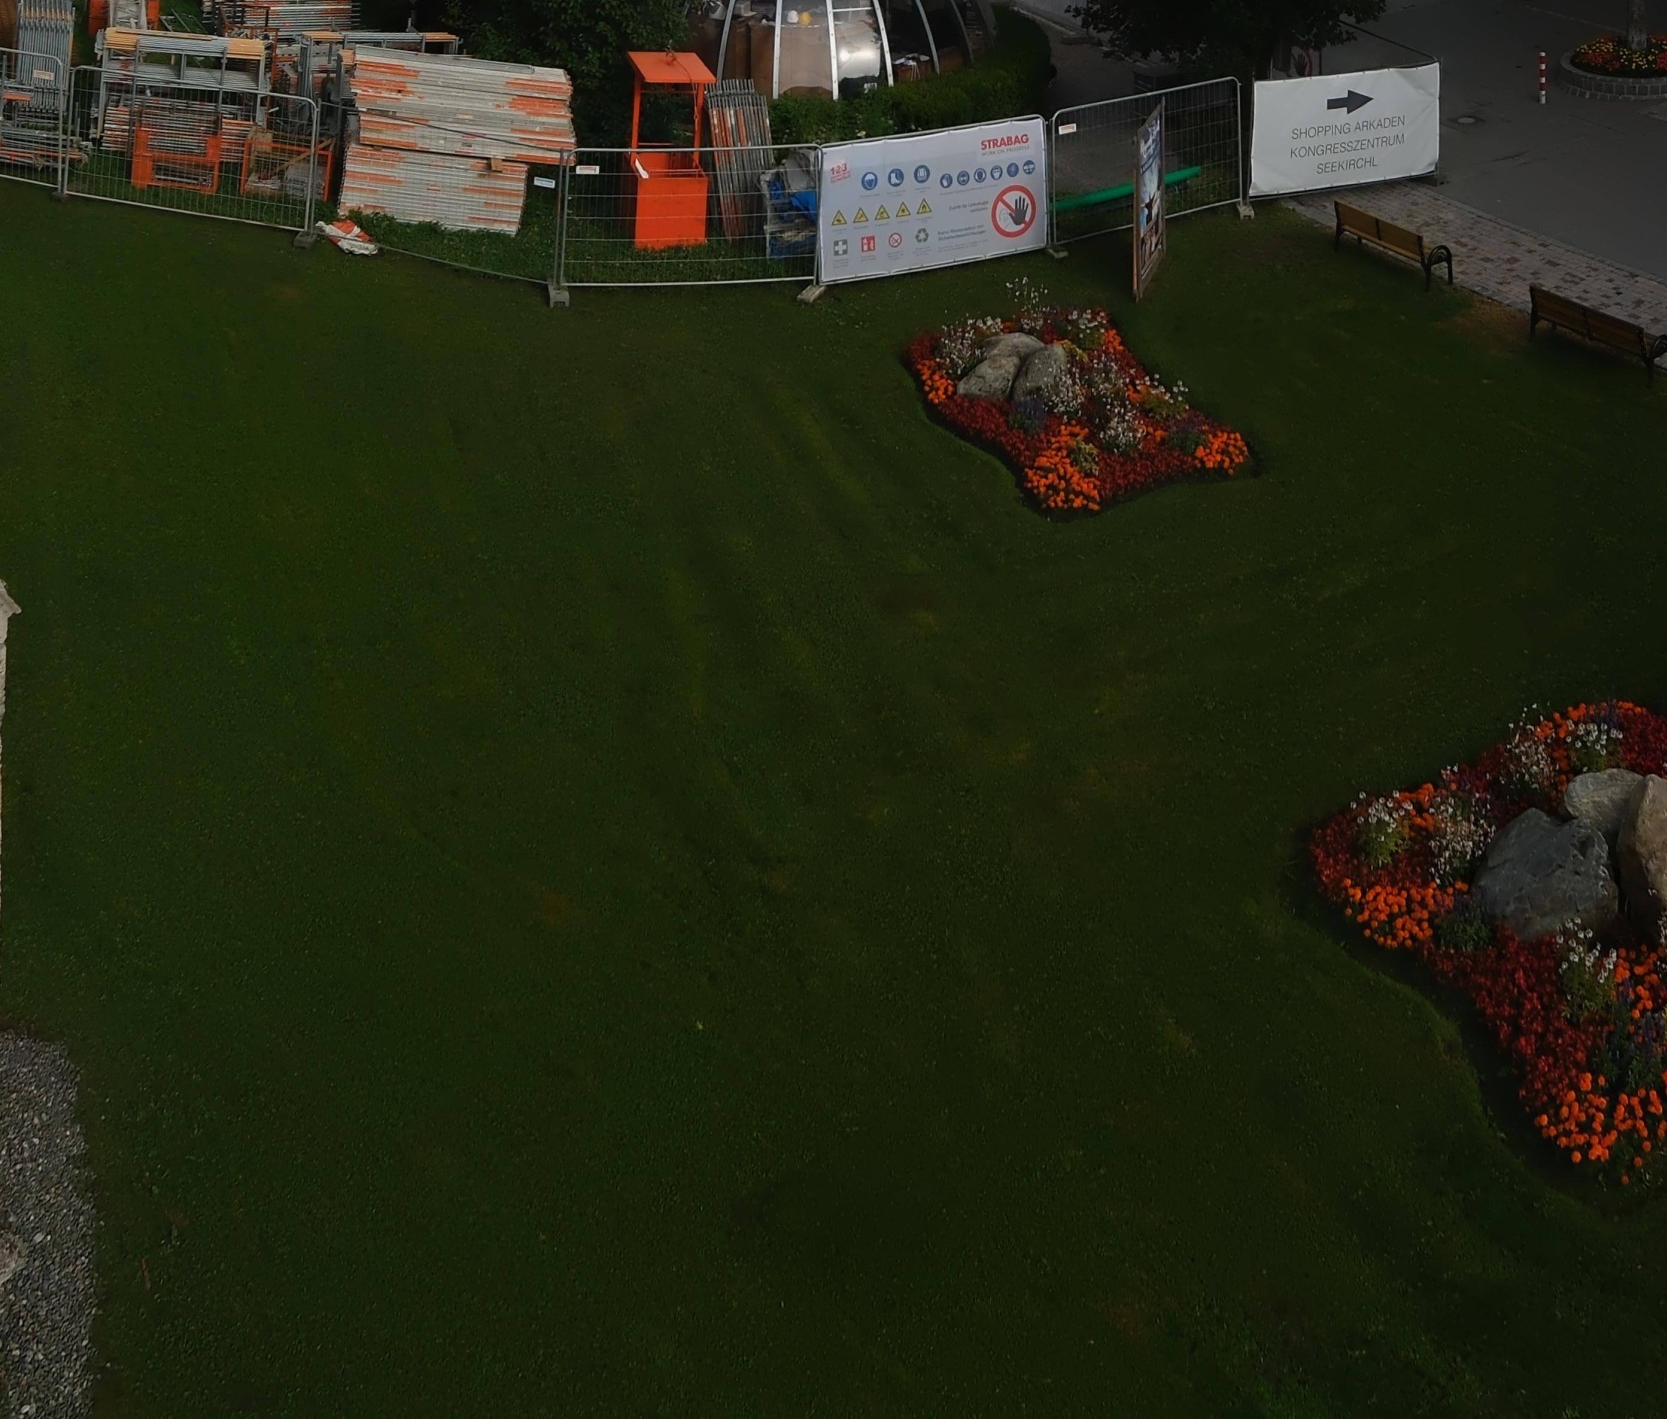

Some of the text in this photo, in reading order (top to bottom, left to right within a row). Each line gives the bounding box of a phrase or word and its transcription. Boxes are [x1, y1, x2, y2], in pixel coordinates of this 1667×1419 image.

[1291, 115, 1406, 140] SHOPPING ARKADEN
[981, 133, 1030, 151] STRABAG
[1290, 133, 1405, 159] KONGRESSZENTRUM
[1316, 156, 1379, 175] SEEKIRCHL
